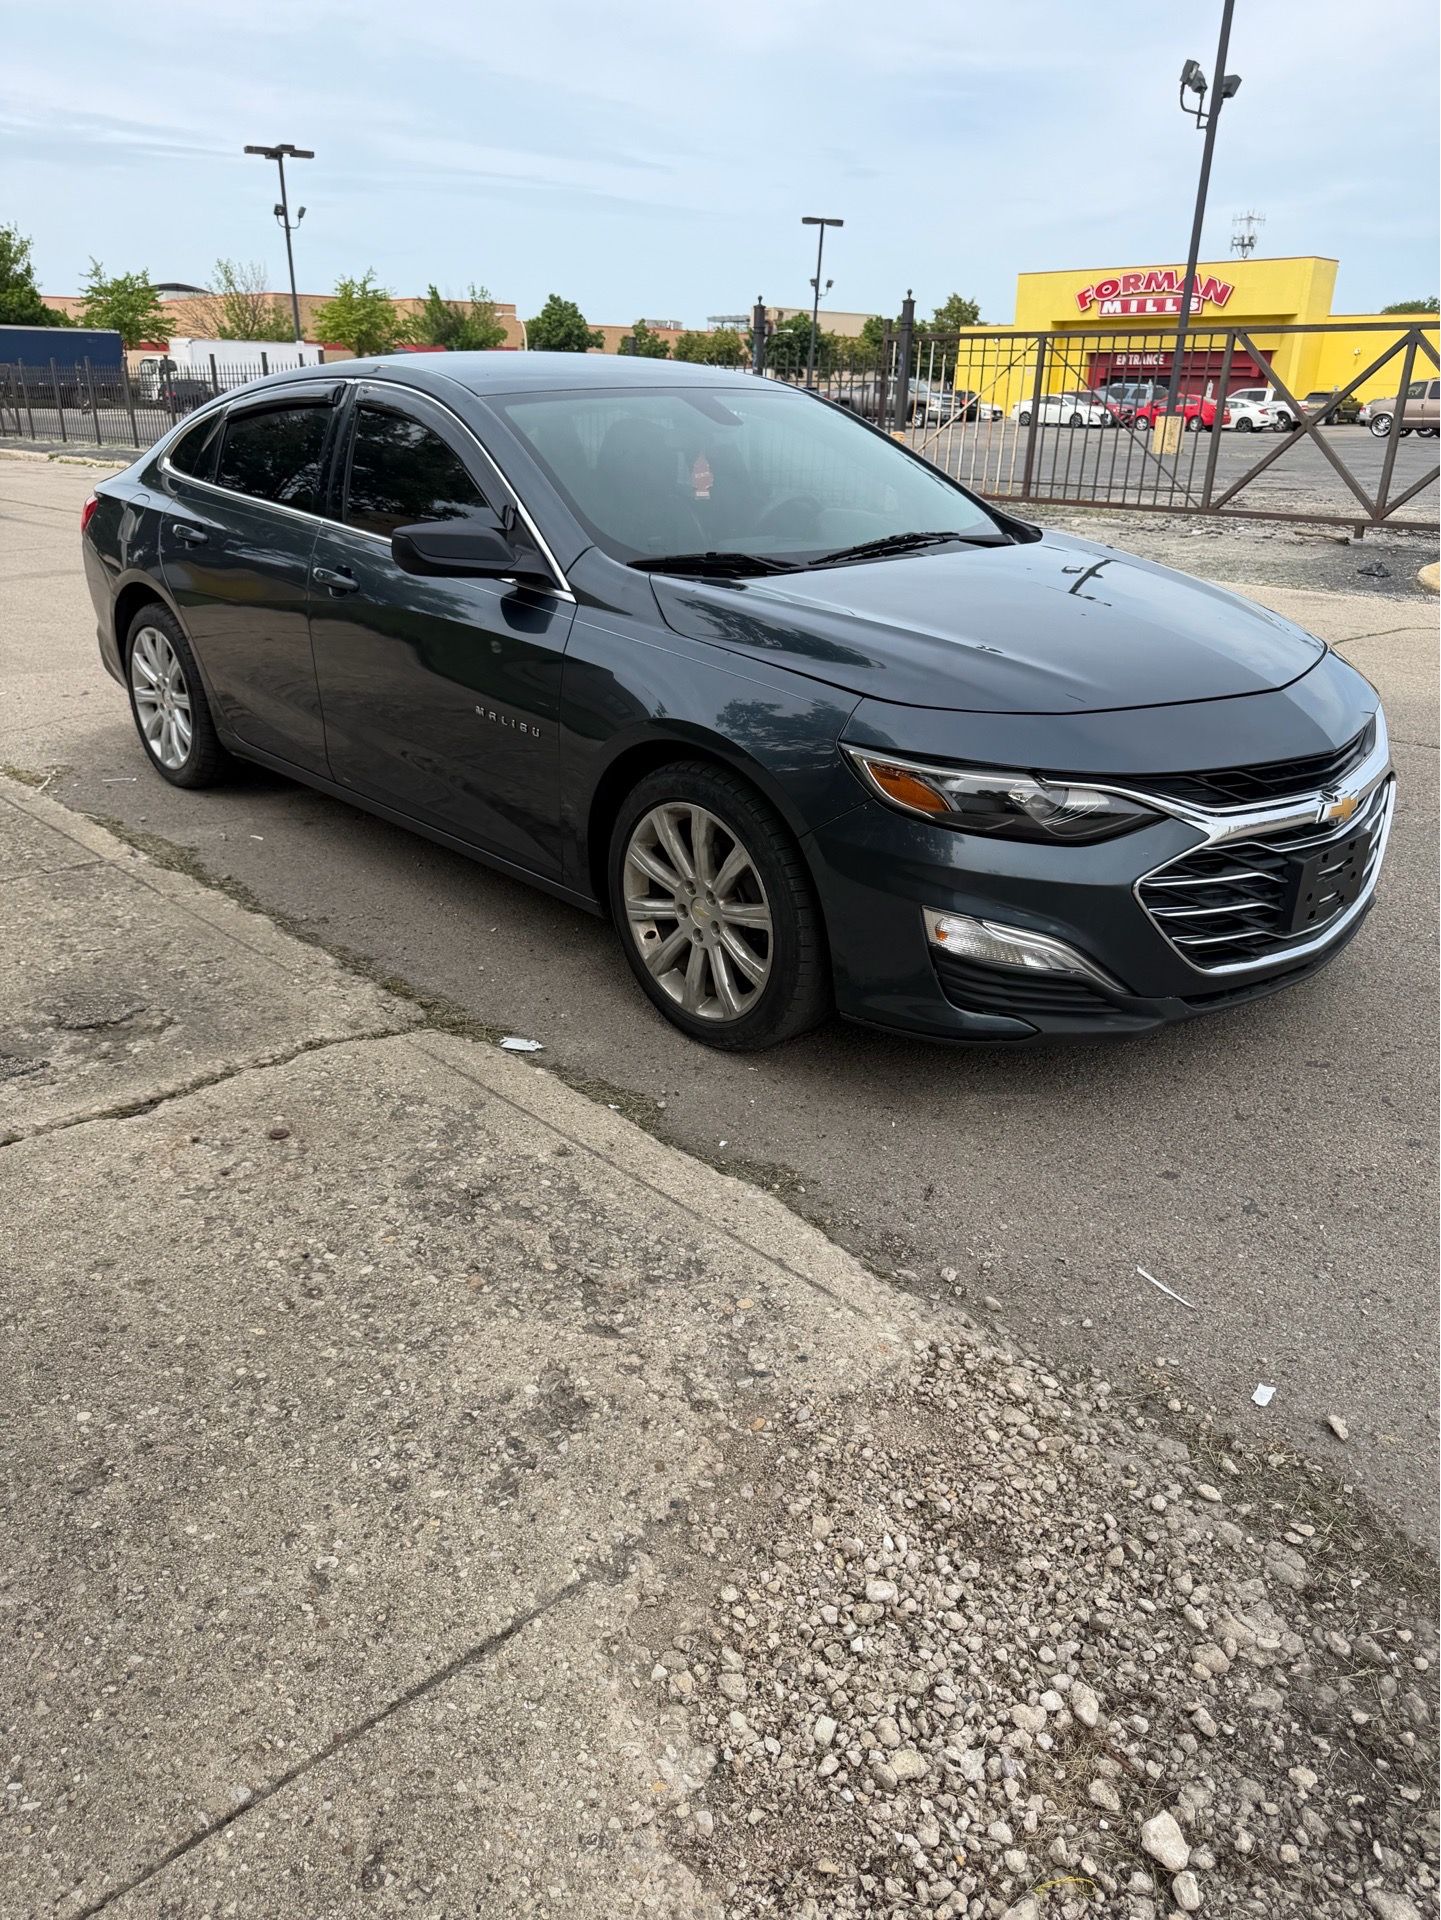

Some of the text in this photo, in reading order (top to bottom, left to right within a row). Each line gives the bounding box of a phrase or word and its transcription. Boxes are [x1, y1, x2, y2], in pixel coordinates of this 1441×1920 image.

[1076, 271, 1233, 311] FORMAN
[1101, 297, 1200, 313] MILLS
[475, 705, 540, 738] MALIBU
